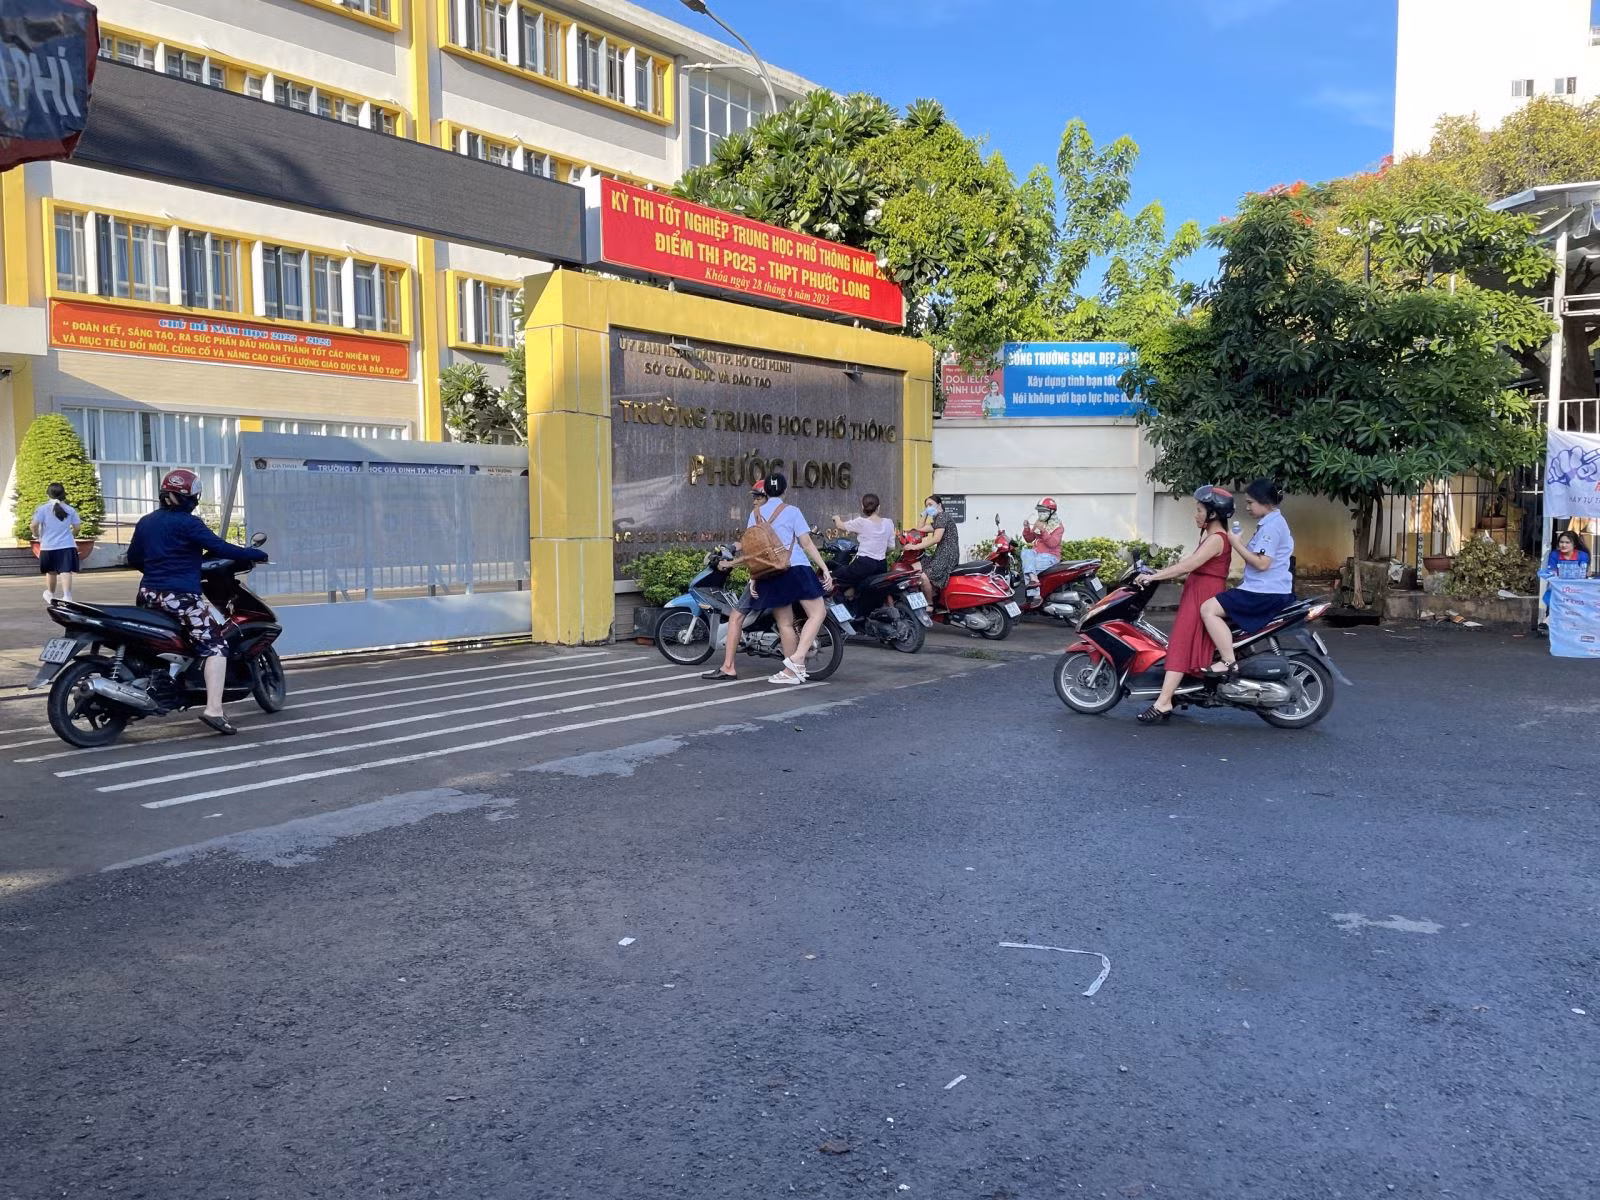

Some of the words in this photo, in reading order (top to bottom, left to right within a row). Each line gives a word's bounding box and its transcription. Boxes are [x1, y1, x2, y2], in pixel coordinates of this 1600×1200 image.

[611, 189, 629, 213] KỲ
[633, 196, 654, 220] THI
[658, 201, 681, 227] TỐT
[684, 211, 729, 241] NGHIỆP
[732, 224, 769, 250] TRUNG
[772, 235, 793, 258] HỌC
[796, 240, 817, 262] PHỔ
[819, 248, 850, 271] THÔNG
[852, 256, 874, 277] NĂM
[655, 230, 694, 259] ĐIỂM
[697, 242, 719, 265] THI
[768, 261, 798, 283] THPT
[801, 269, 839, 292] PHƯỚC
[842, 279, 870, 300] LONG
[705, 268, 728, 283] Khóa
[730, 275, 750, 289] ngày
[753, 279, 762, 289] 28
[764, 282, 786, 298] tháng
[788, 287, 793, 297] 6
[795, 290, 810, 301] năm
[813, 292, 830, 305] 2023
[62, 332, 76, 343] VÀ
[80, 336, 101, 347] MỤC
[105, 337, 127, 349] TIÊU
[129, 339, 146, 350] ĐỔI
[172, 344, 196, 355] CỦNG
[198, 345, 211, 356] CỐ
[213, 347, 224, 358] VÀ
[227, 347, 250, 360] NÂNG
[252, 353, 269, 362] CAO
[270, 354, 291, 365] CHẤT
[294, 357, 319, 368] LƯỢNG
[321, 359, 339, 369] GIÁO
[341, 362, 356, 372] DỤC
[358, 363, 367, 372] VÀ
[369, 364, 384, 374] ĐÀO
[72, 320, 99, 332] ĐOÀN
[103, 323, 125, 336] KẾT,
[128, 326, 153, 338] SÁNG
[155, 330, 176, 342] TẠO,
[179, 333, 191, 342] RA
[194, 331, 211, 343] SỨC
[213, 334, 237, 347] PHẤN
[239, 338, 257, 349] ĐẤU
[259, 340, 281, 351] HOÀN
[283, 342, 309, 354] THÀNH
[312, 346, 326, 357] TỐT
[329, 349, 343, 359] CÁC
[345, 351, 369, 362] NHIỆM
[370, 354, 381, 363] VỤ
[768, 361, 792, 373] MINH
[1034, 349, 1070, 365] TRƯỜNG
[1071, 352, 1097, 368] SẠCH,
[718, 370, 730, 384] VÀ
[732, 373, 751, 387] ĐÀO
[754, 376, 771, 389] TẠO
[945, 375, 965, 383] DOL
[1027, 375, 1043, 388] Xây
[1045, 374, 1066, 389] dựng
[1067, 374, 1085, 386] tình
[1086, 375, 1102, 389] bạn
[1012, 392, 1027, 404] Nói
[1028, 392, 1055, 405] không
[1056, 391, 1070, 404] với
[1071, 391, 1087, 406] bạo
[1088, 391, 1103, 406] lực
[1103, 391, 1120, 406] học
[618, 397, 706, 428] TRƯỜNG
[711, 409, 773, 434] TRUNG
[777, 414, 812, 440] HỌC
[815, 413, 847, 440] PHỔ
[848, 417, 896, 443] THÔNG
[318, 463, 350, 472] TRƯỜNG
[790, 458, 852, 490] LONG
